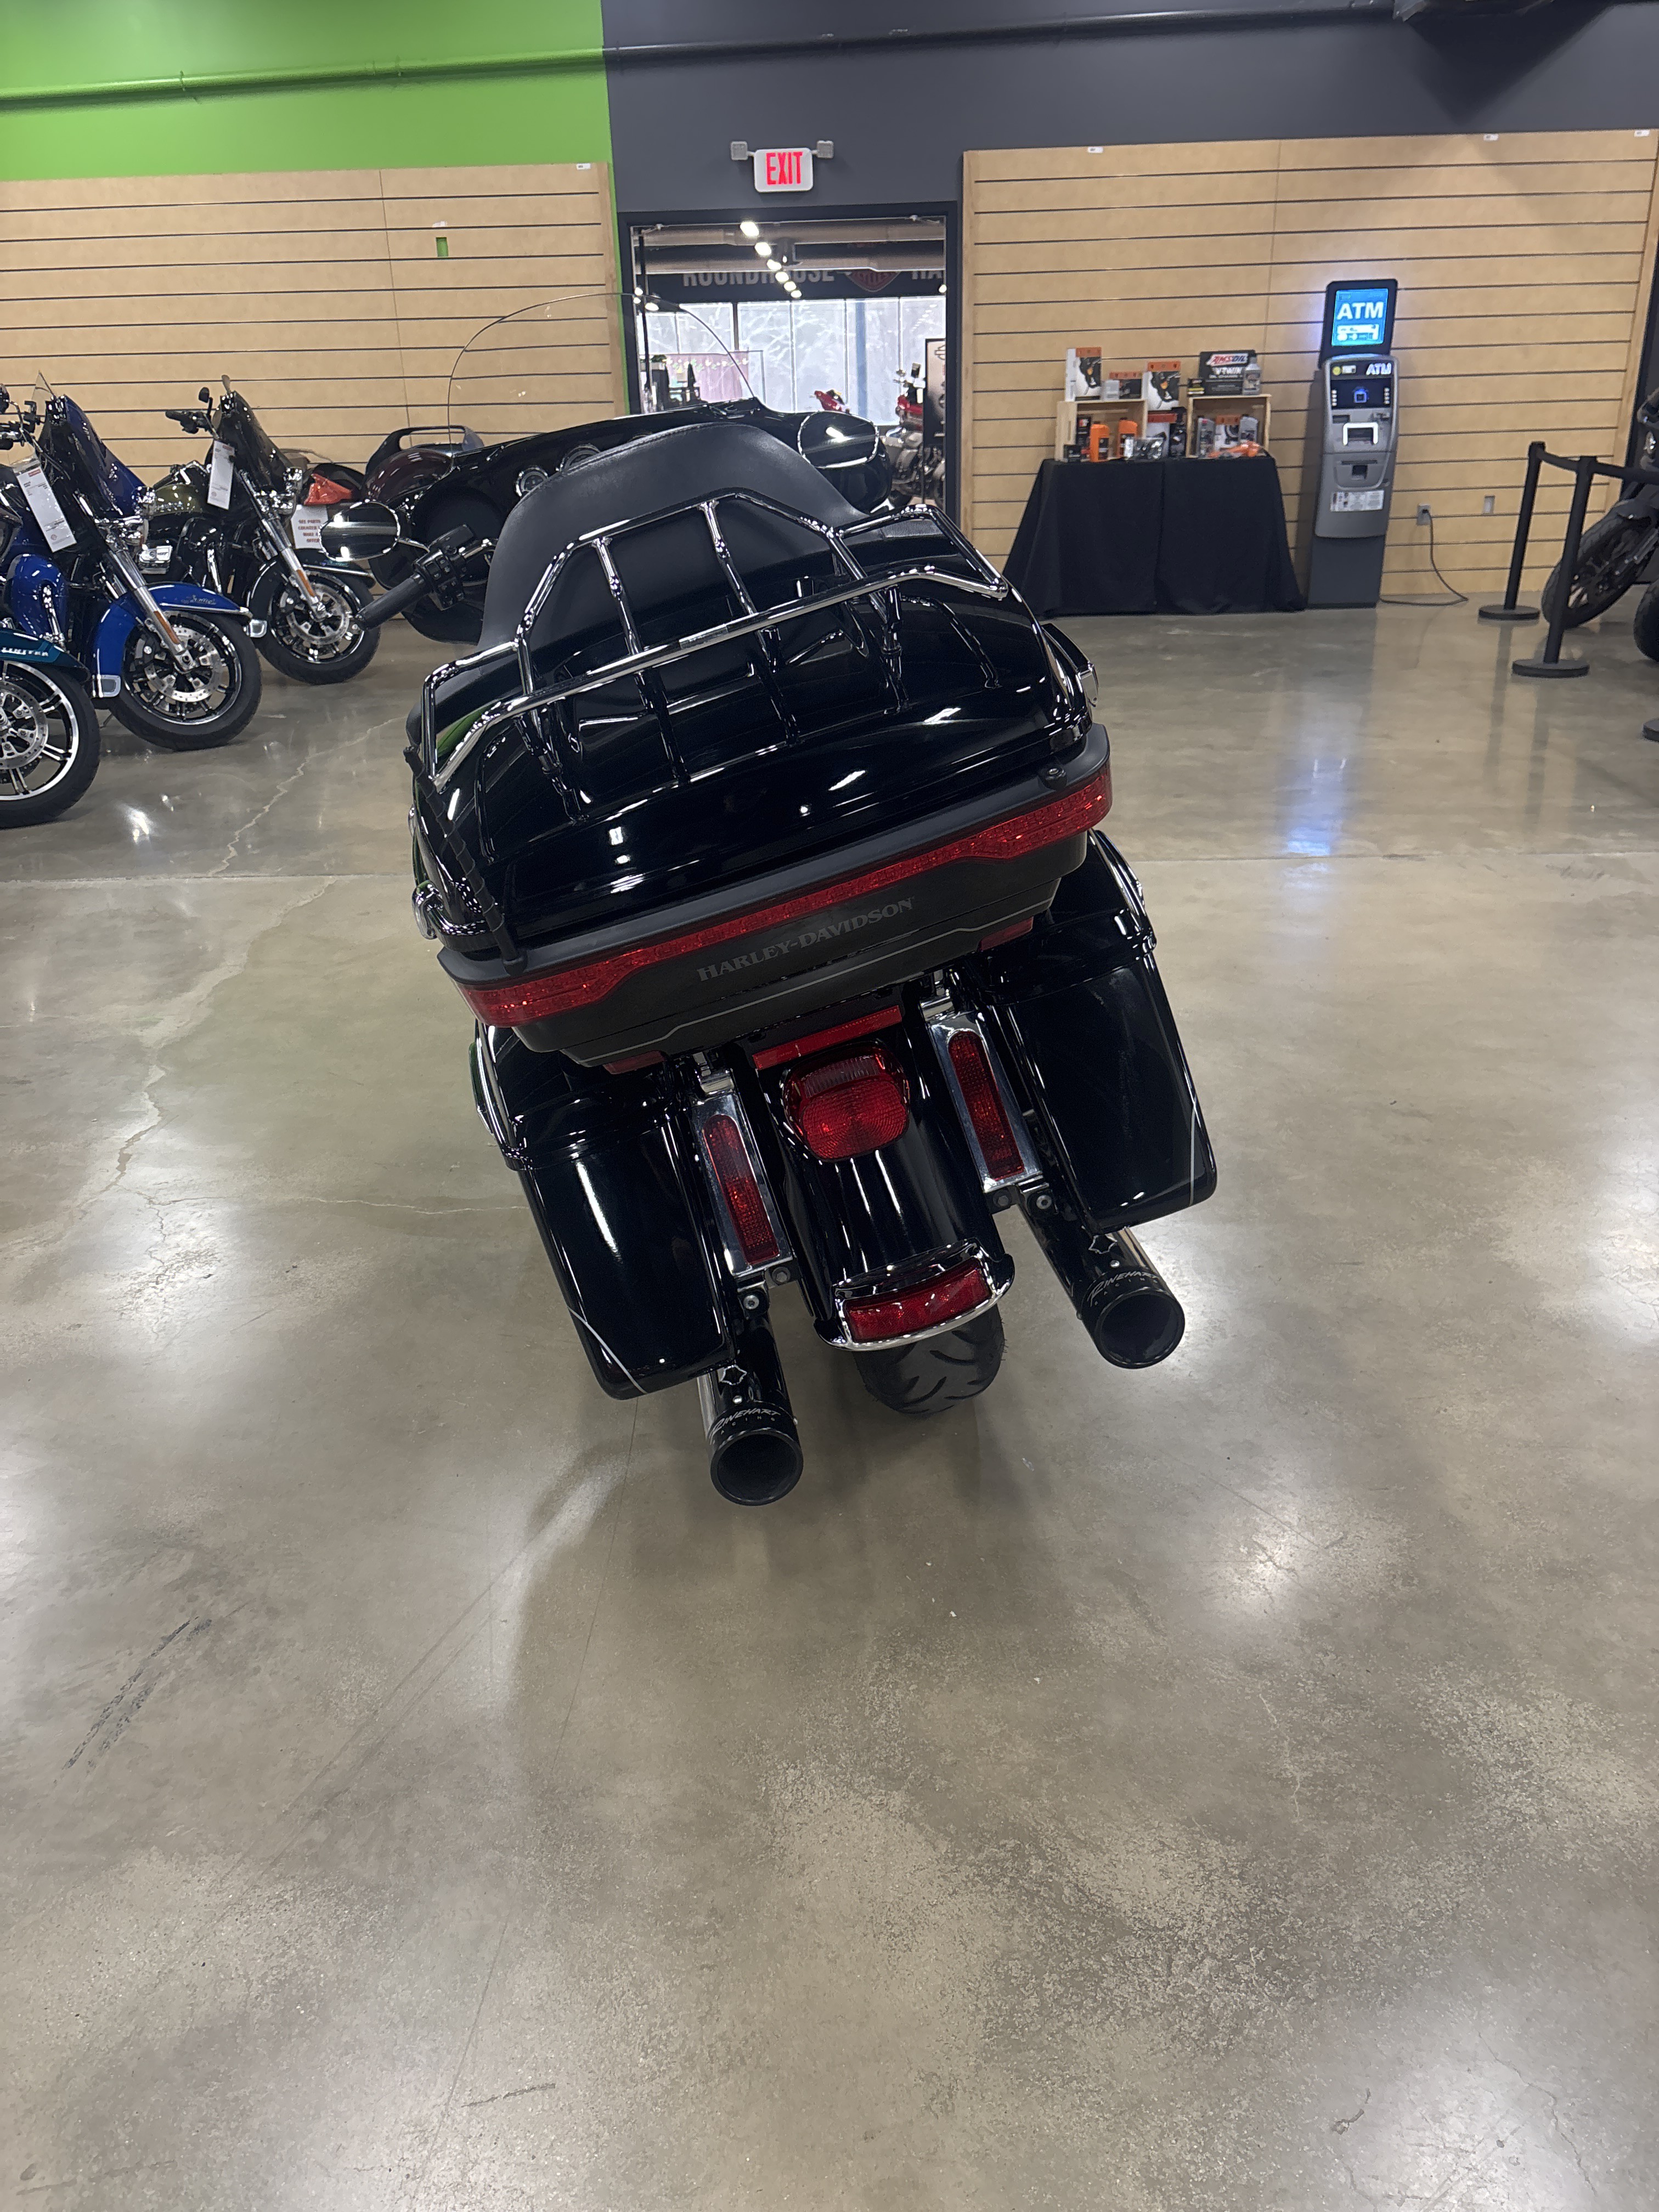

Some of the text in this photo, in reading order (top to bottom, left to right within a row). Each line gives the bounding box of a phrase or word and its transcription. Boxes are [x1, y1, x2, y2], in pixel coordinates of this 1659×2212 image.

[766, 151, 803, 185] EXIT
[1337, 302, 1384, 320] ATM
[1212, 355, 1246, 364] AMSOIL
[1366, 363, 1392, 375] ATM
[696, 896, 915, 982] HARLEY-DAVIDSON
[1087, 1271, 1160, 1307] RINEHART
[709, 1407, 781, 1446] RINEHART
